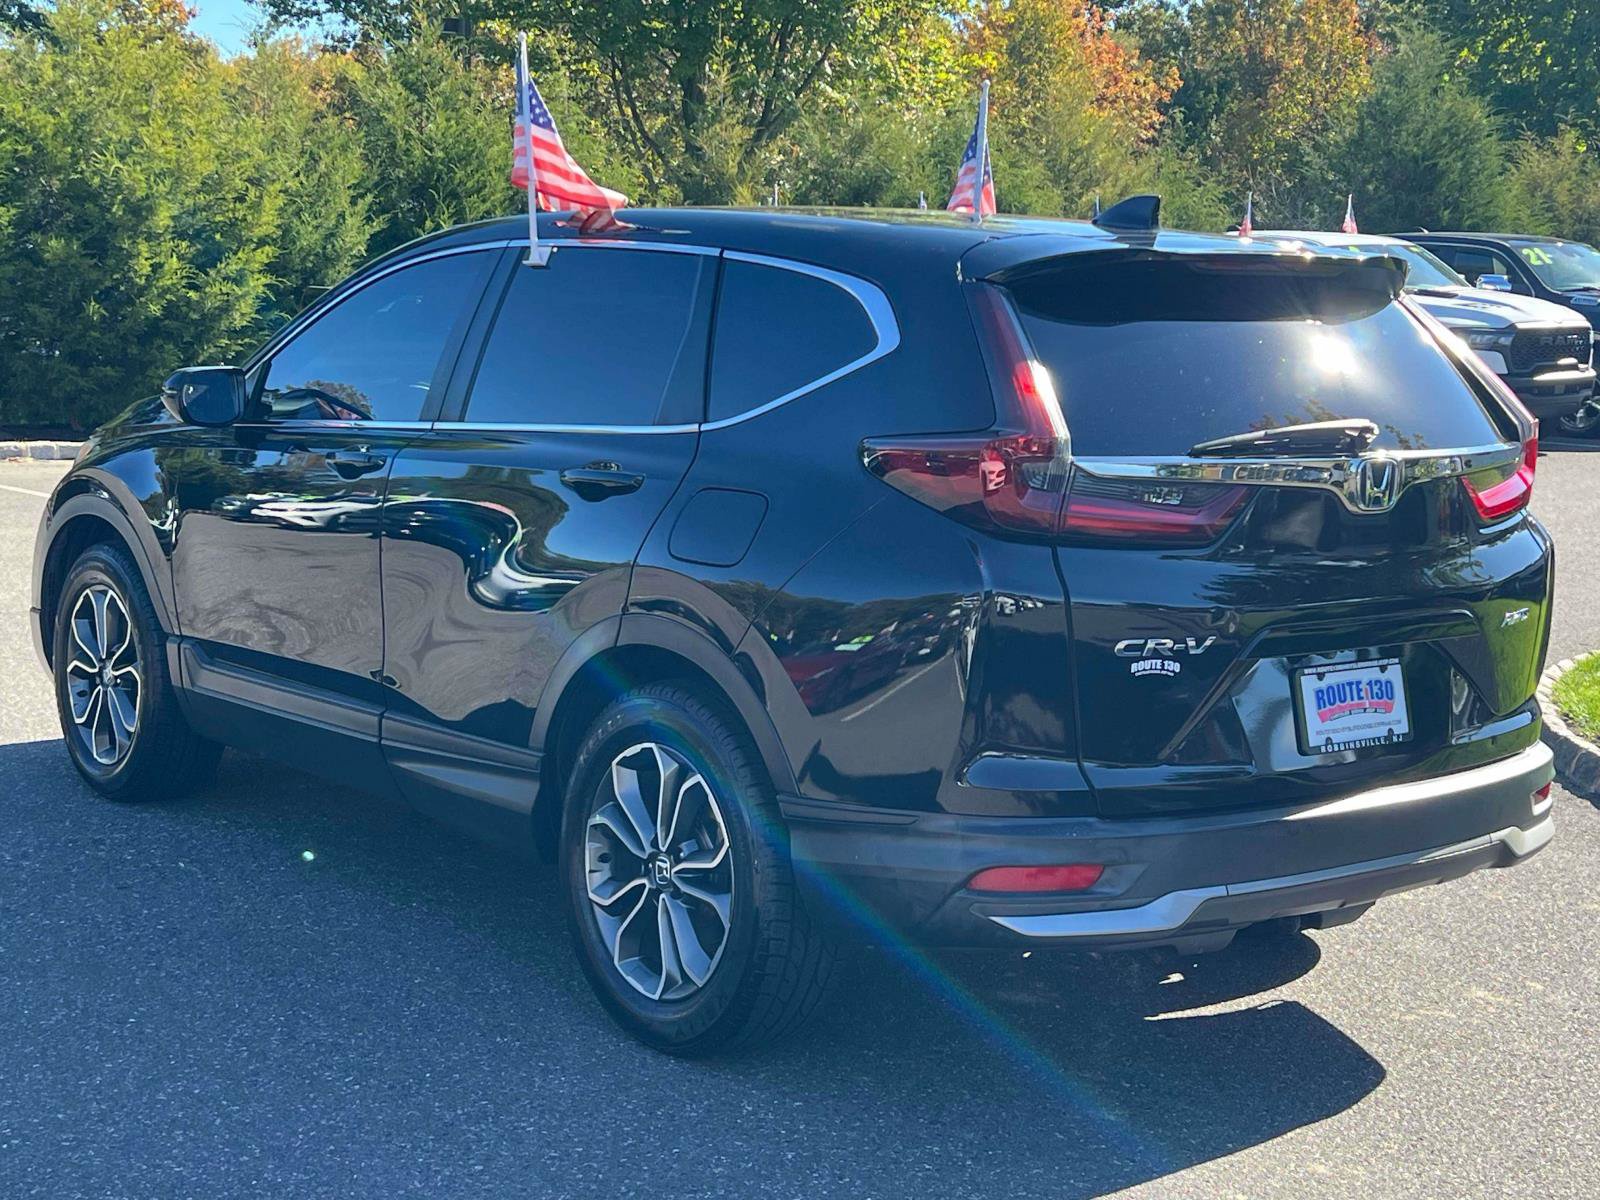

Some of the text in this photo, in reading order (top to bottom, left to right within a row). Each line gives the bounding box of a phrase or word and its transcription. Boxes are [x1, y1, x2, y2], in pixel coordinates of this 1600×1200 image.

[1114, 636, 1217, 657] CR-V
[1130, 659, 1163, 673] ROUTE
[1163, 660, 1181, 673] 130
[1315, 679, 1395, 710] ROUTE 130
